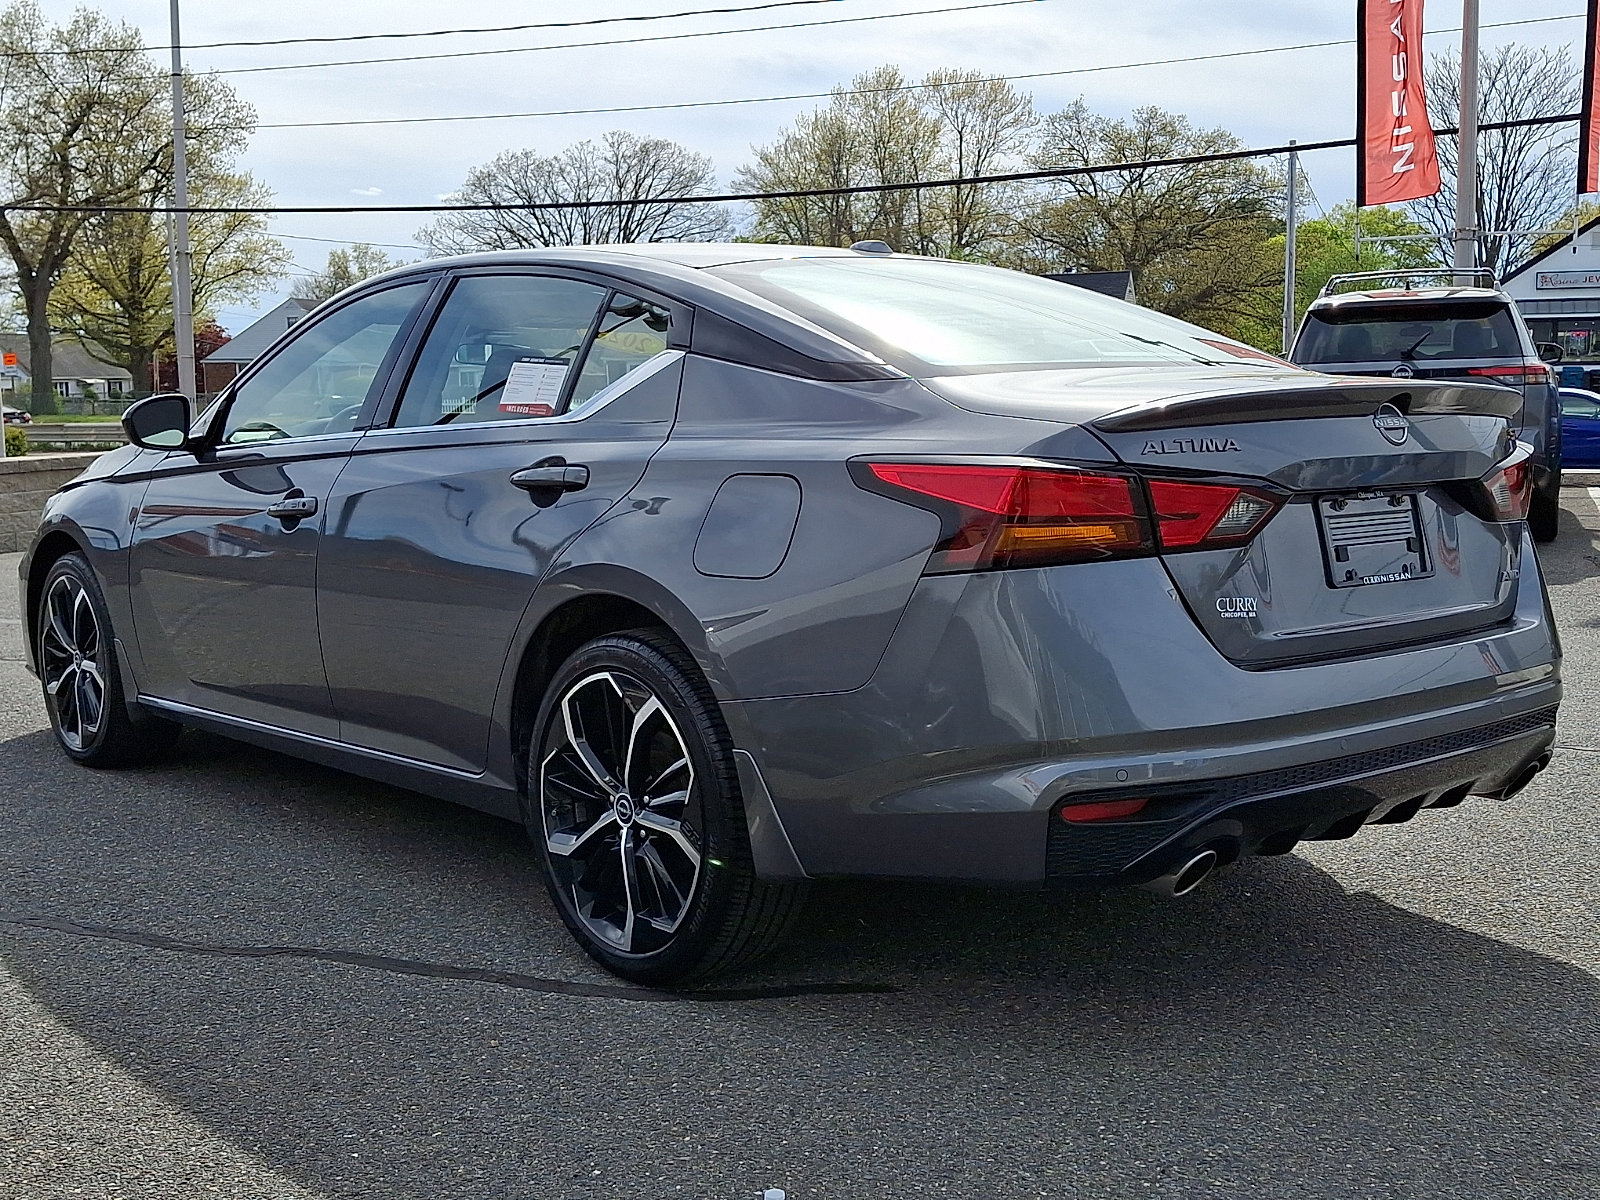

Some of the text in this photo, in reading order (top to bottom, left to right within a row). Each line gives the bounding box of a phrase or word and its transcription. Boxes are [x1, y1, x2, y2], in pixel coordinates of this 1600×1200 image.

[1390, 0, 1415, 174] NISSA
[1141, 438, 1242, 456] ALTIMA
[1381, 572, 1411, 582] NISSAN
[1216, 597, 1258, 612] CURRY
